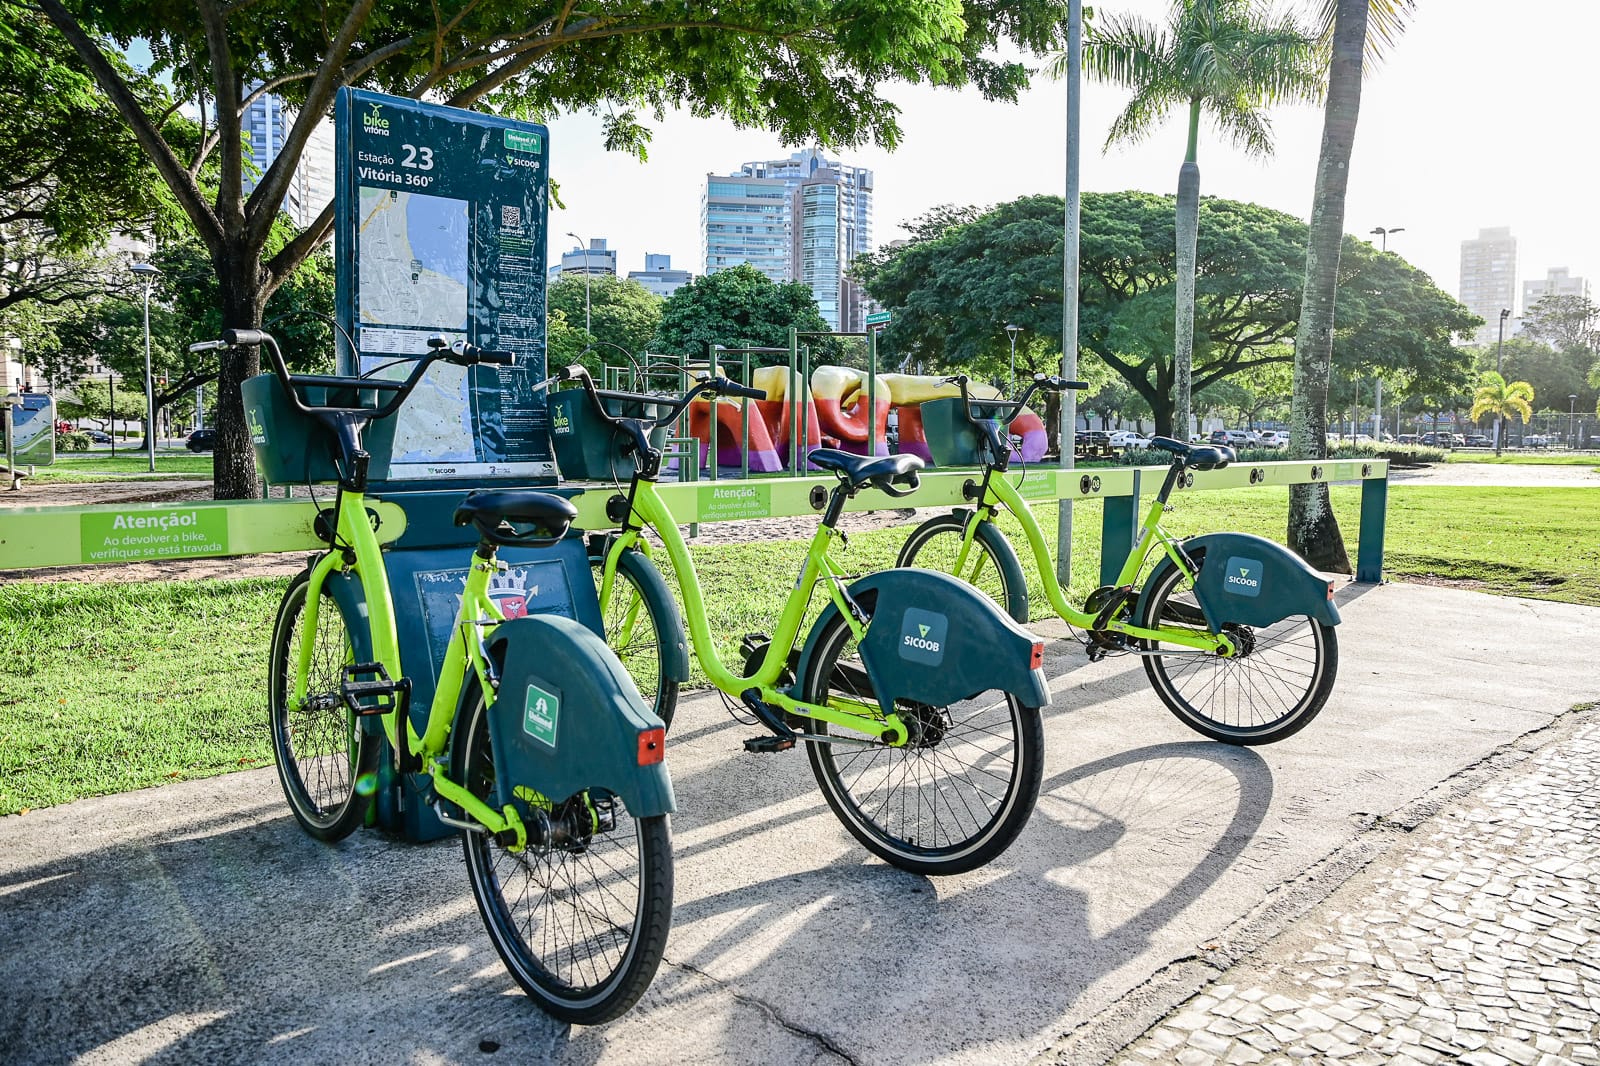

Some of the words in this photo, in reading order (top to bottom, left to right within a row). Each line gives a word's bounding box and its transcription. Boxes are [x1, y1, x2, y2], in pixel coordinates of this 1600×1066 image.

[363, 112, 390, 129] bike
[363, 125, 390, 137] vitória
[358, 151, 395, 165] Estação
[401, 143, 434, 171] 23
[513, 158, 541, 169] SICOOB
[358, 166, 403, 184] Vitória
[713, 486, 756, 500] Atenção!
[112, 511, 197, 531] Atenção!
[103, 536, 120, 546] Ao
[122, 534, 169, 545] devolver
[173, 533, 179, 542] a
[182, 531, 207, 542] bike,
[89, 547, 140, 559] verifique
[143, 547, 155, 556] se
[158, 545, 180, 554] está
[183, 542, 222, 553] travada
[1228, 575, 1258, 587] SICOOB
[903, 635, 940, 652] SICOOB
